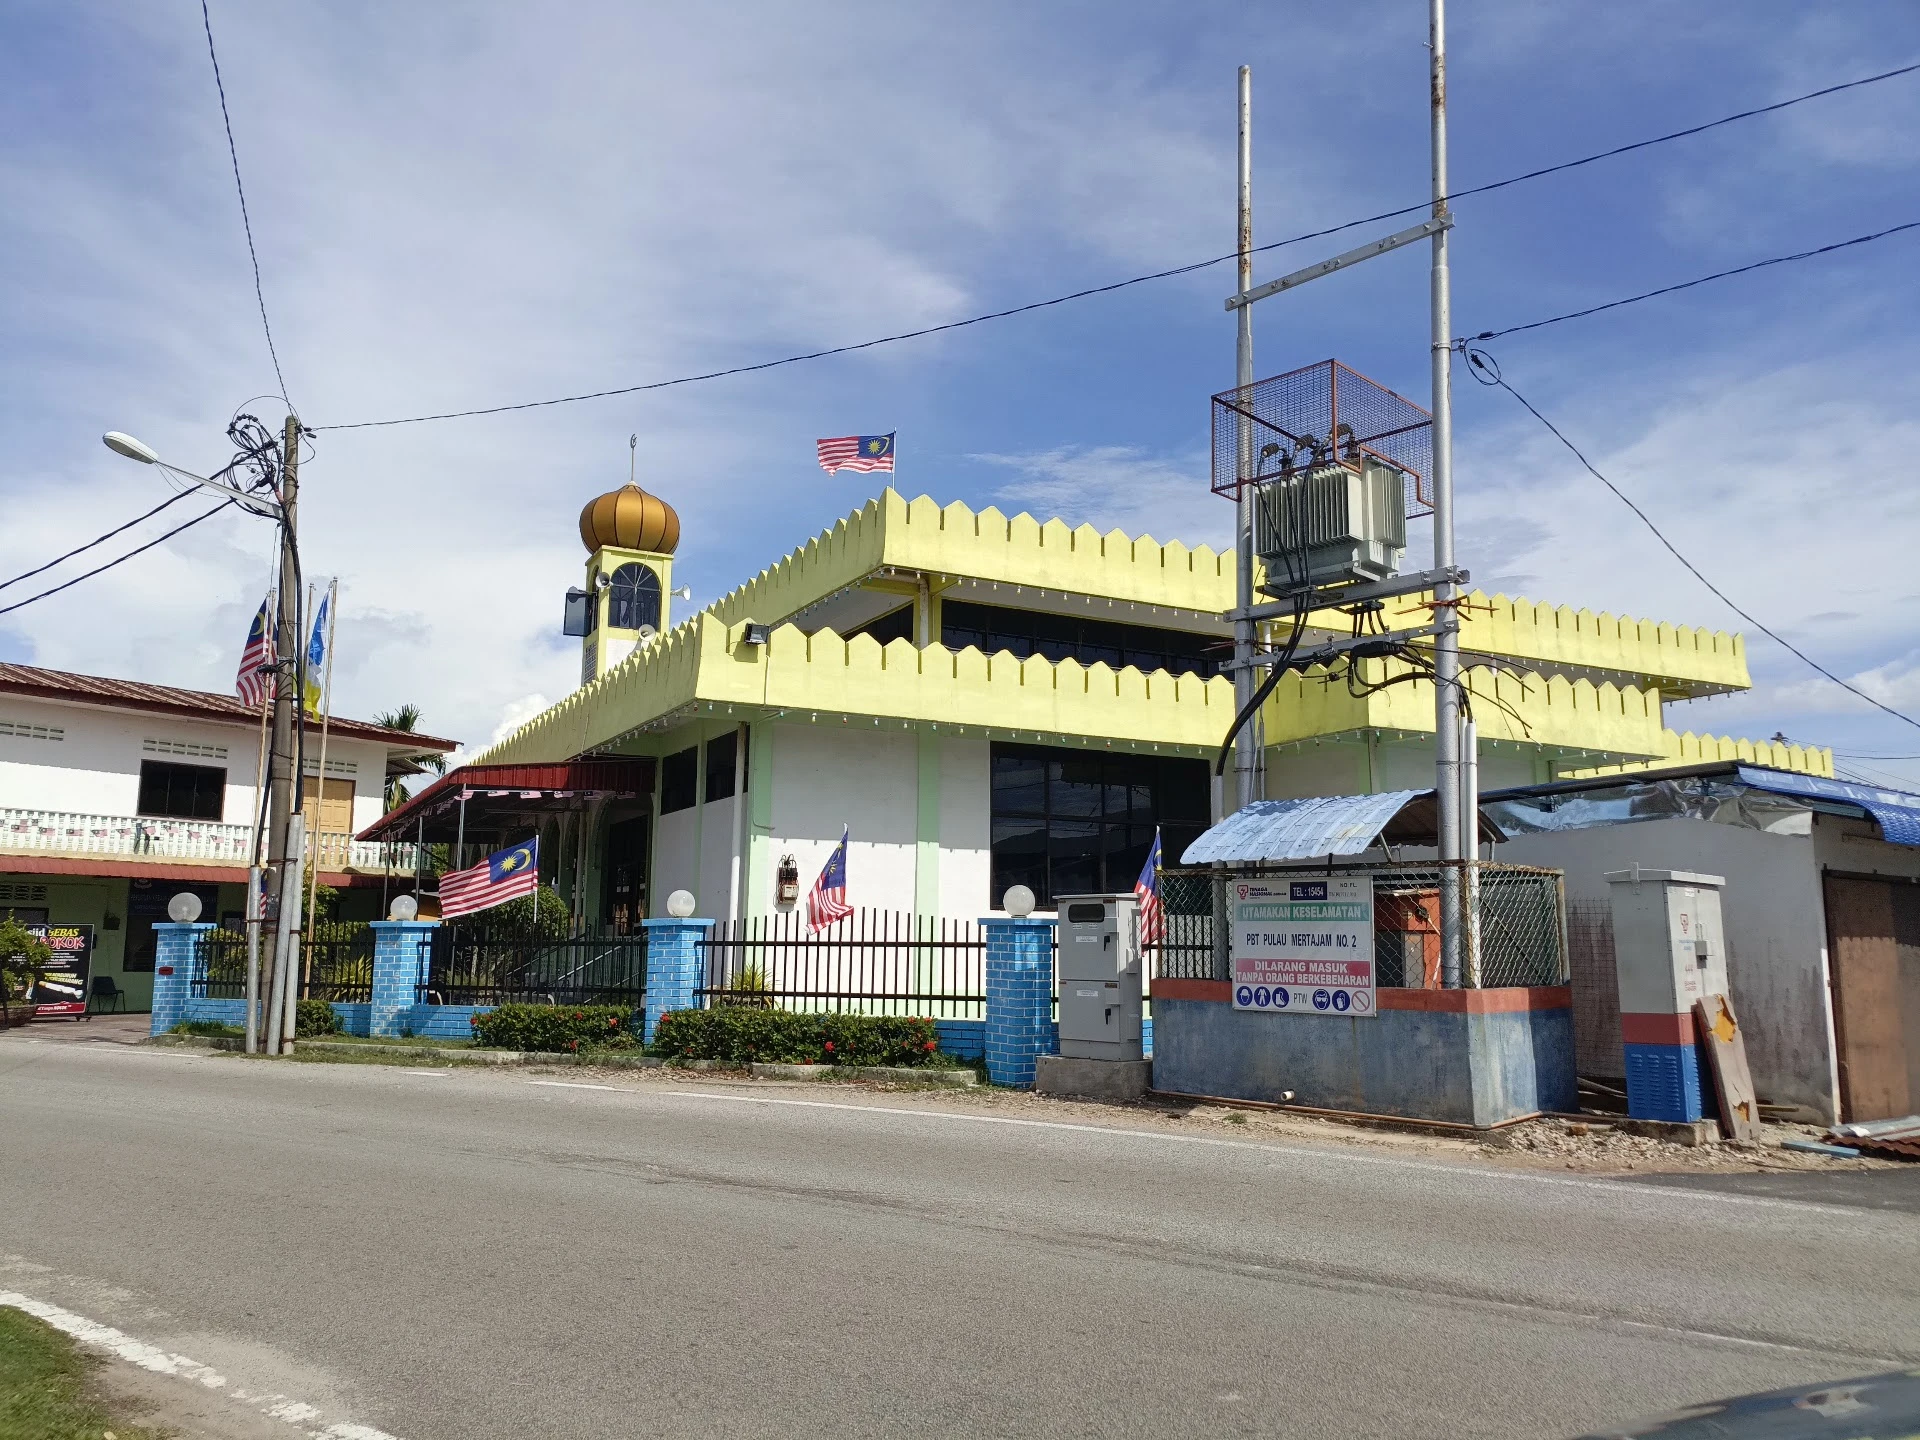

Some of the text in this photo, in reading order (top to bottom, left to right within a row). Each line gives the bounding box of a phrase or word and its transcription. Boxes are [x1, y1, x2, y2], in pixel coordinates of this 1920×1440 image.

[1308, 887, 1324, 896] 15454
[1242, 905, 1361, 918] UTAMAKAN KESELAMATAN
[1246, 933, 1357, 947] PBT PULAU MERTAJAM NO. 2
[1254, 960, 1348, 973] DILARANG MASUK
[1237, 972, 1369, 986] TANPA ORANG BERKEBENARAN
[1293, 993, 1308, 1004] PTW
